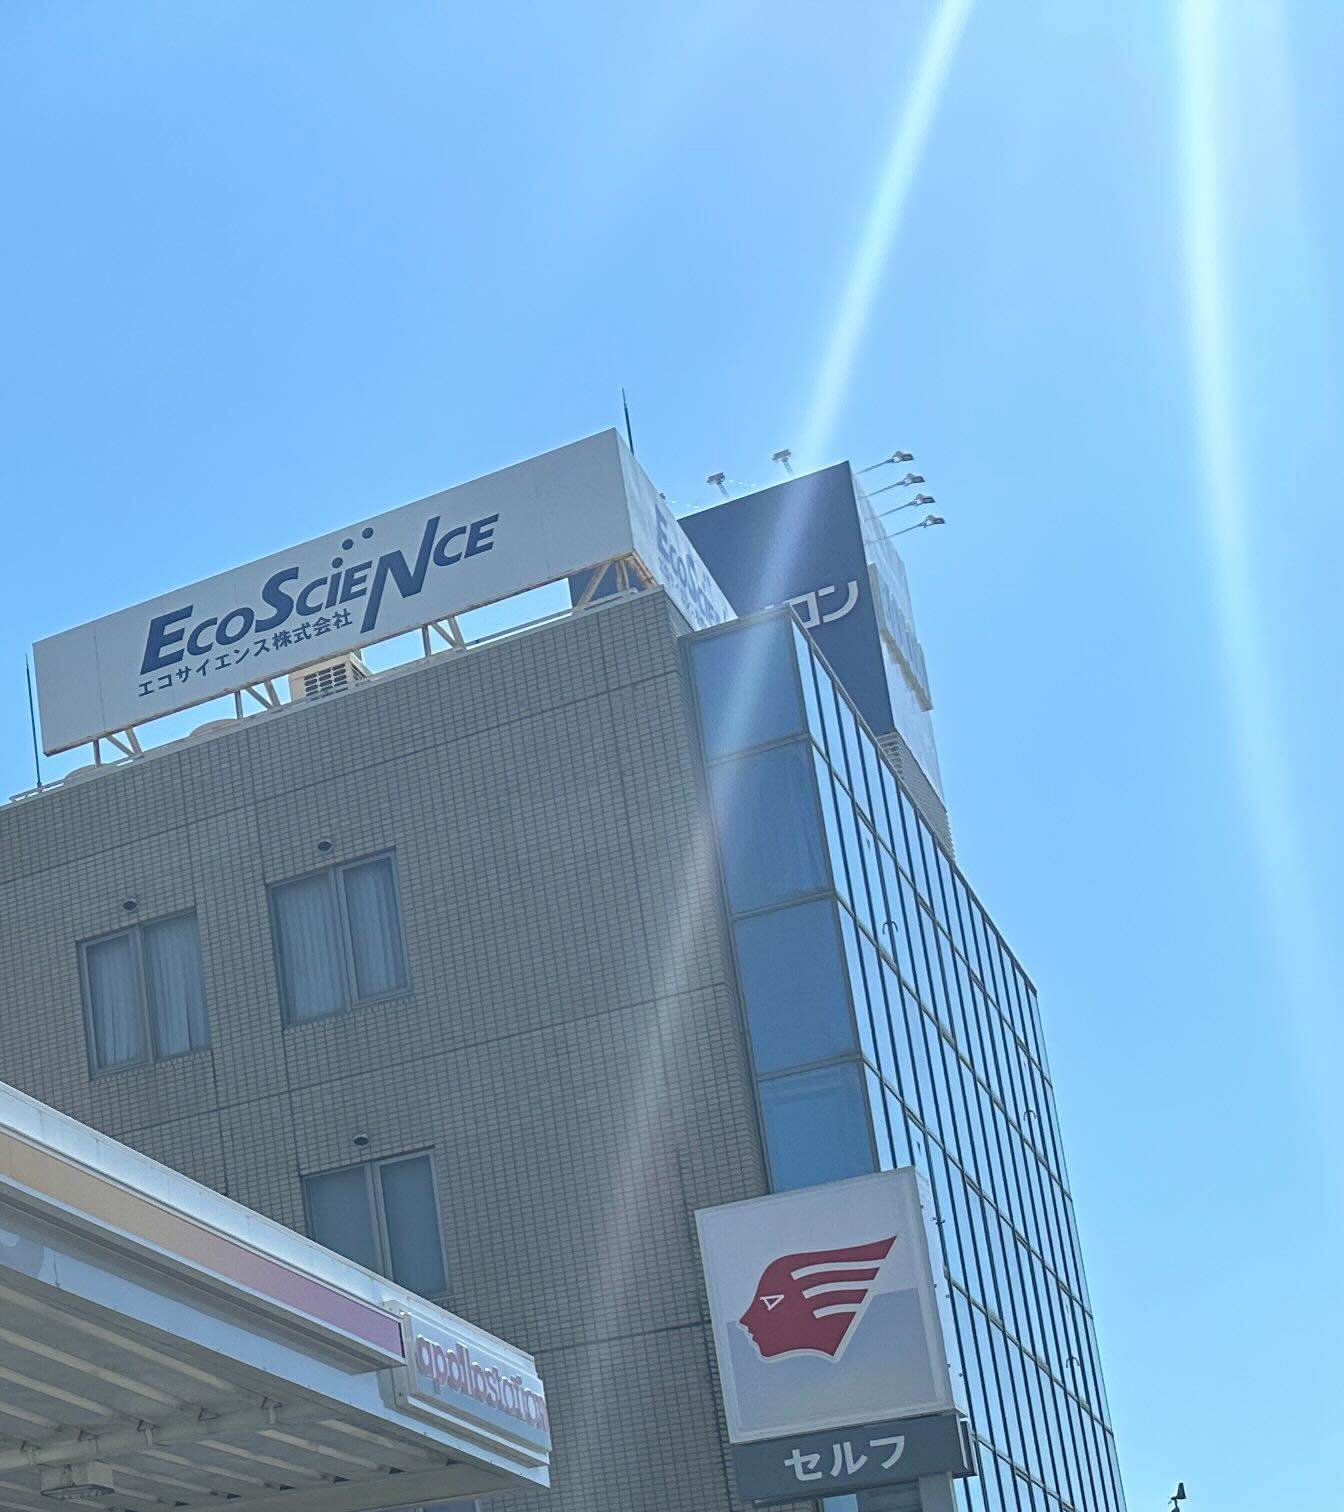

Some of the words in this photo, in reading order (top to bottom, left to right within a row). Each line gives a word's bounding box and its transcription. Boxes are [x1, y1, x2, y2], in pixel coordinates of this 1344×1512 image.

[138, 607, 353, 698] エコサイエンス株式会社
[784, 1435, 905, 1482] セルフ
